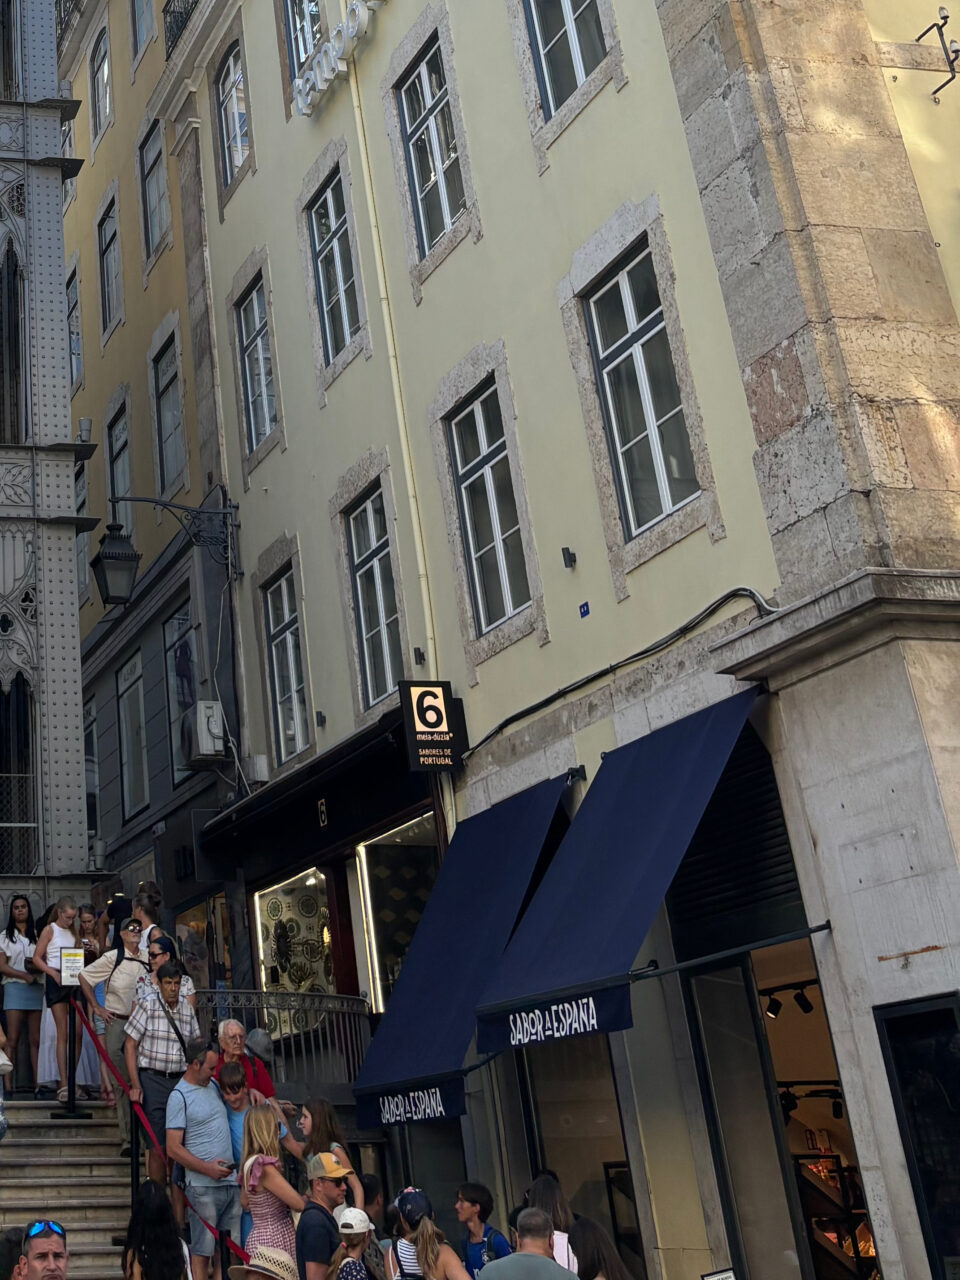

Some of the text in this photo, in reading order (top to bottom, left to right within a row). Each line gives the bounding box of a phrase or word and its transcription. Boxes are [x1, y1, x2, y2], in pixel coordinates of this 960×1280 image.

[416, 690, 444, 729] 6
[418, 748, 443, 756] SABORES
[419, 757, 453, 765] PORTUGAL
[509, 1009, 545, 1045] SABOR
[551, 997, 598, 1038] ESPAÑA
[379, 1094, 406, 1124] SABOR
[409, 1087, 446, 1120] ESPAÑA
